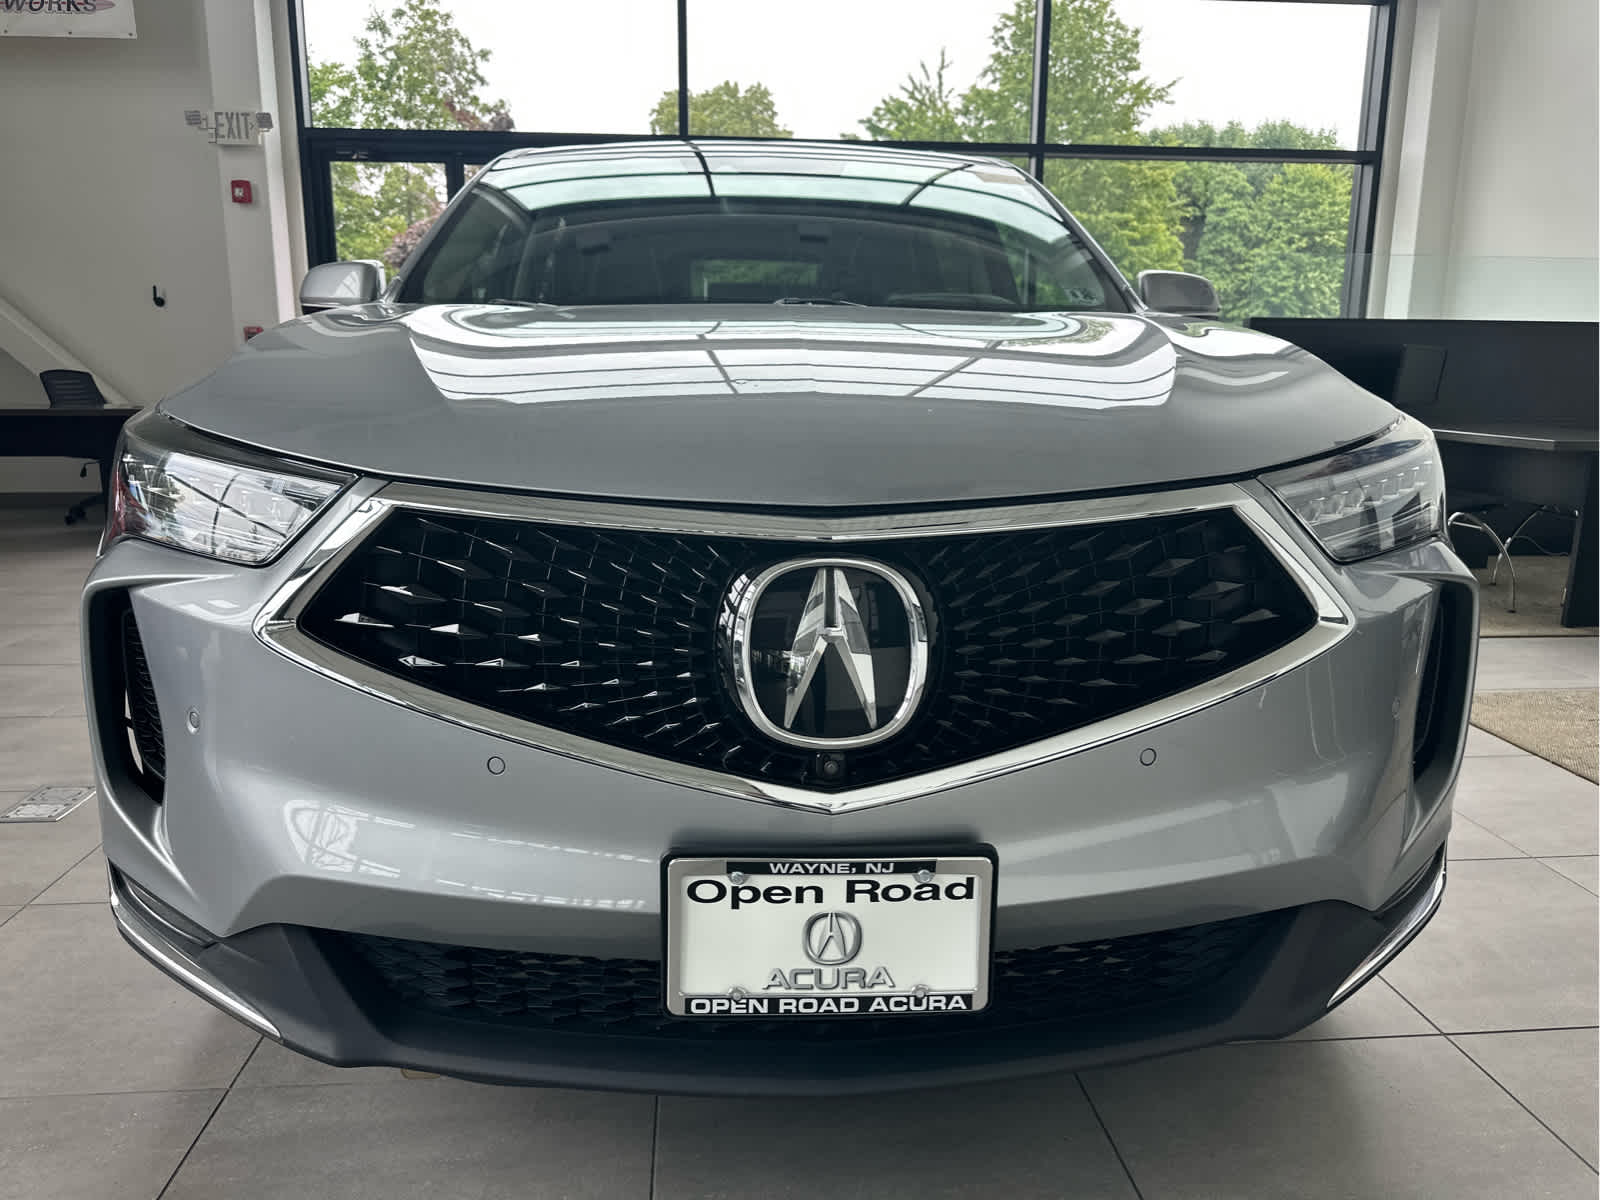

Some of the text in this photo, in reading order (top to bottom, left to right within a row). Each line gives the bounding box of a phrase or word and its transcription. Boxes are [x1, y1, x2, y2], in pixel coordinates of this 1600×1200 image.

[214, 111, 250, 139] EXIT
[769, 862, 895, 874] WAYNE, NJ
[687, 877, 975, 909] Open Road
[762, 967, 896, 990] ACURA
[690, 996, 967, 1014] OPEN ROAD ACURA
